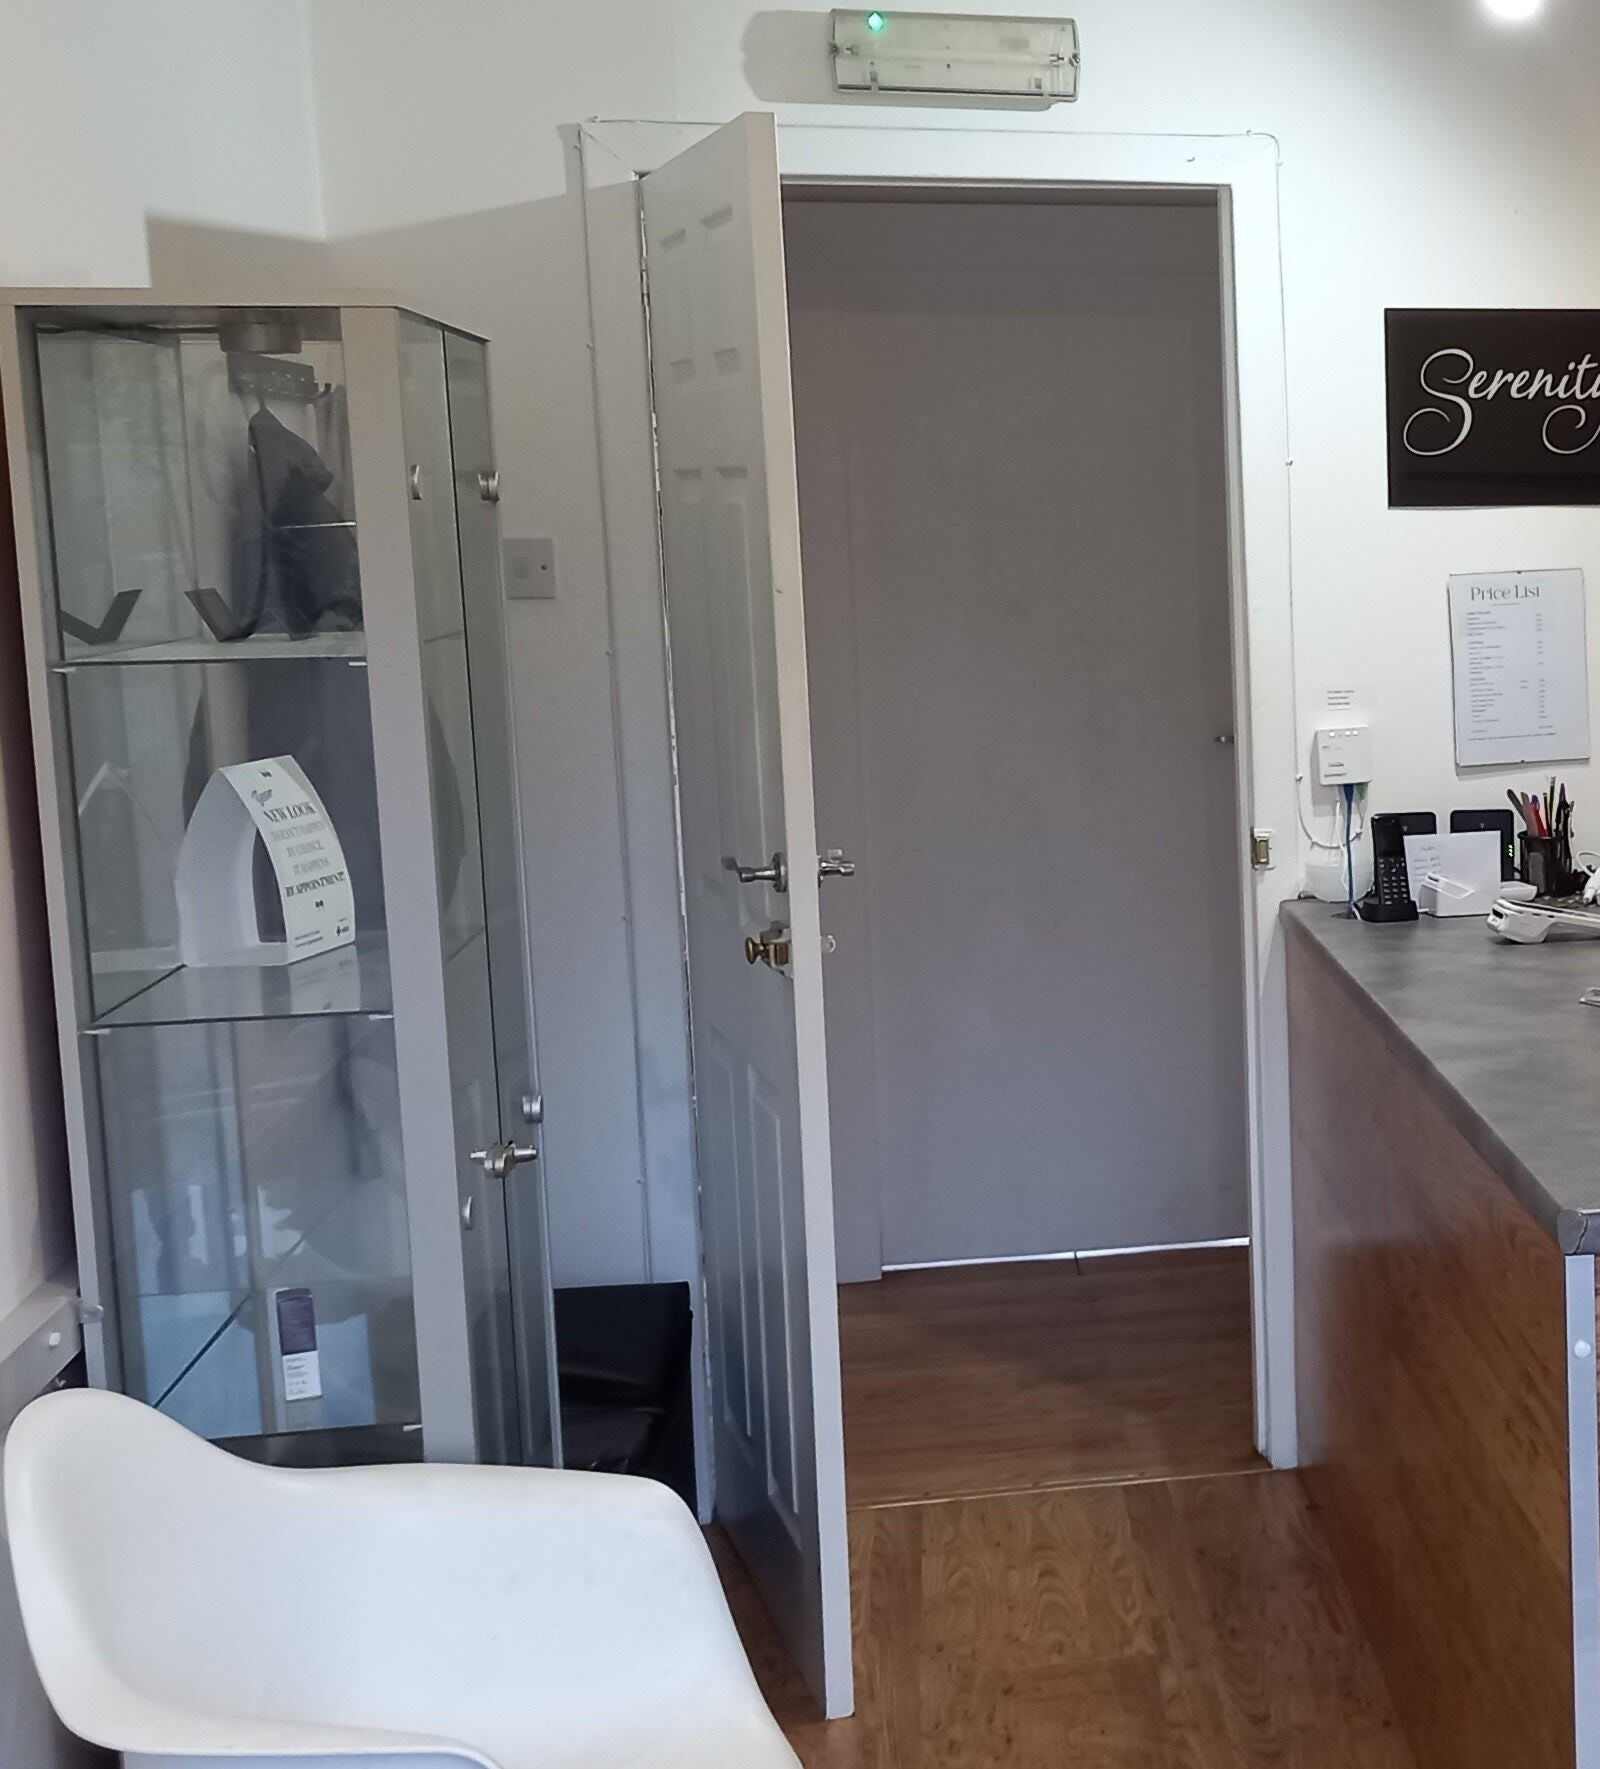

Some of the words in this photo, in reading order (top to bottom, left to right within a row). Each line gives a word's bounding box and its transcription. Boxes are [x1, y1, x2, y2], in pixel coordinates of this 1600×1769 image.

[1470, 587, 1511, 602] Price
[1514, 585, 1541, 599] List
[263, 806, 287, 823] NEW
[286, 801, 317, 820] LOOK
